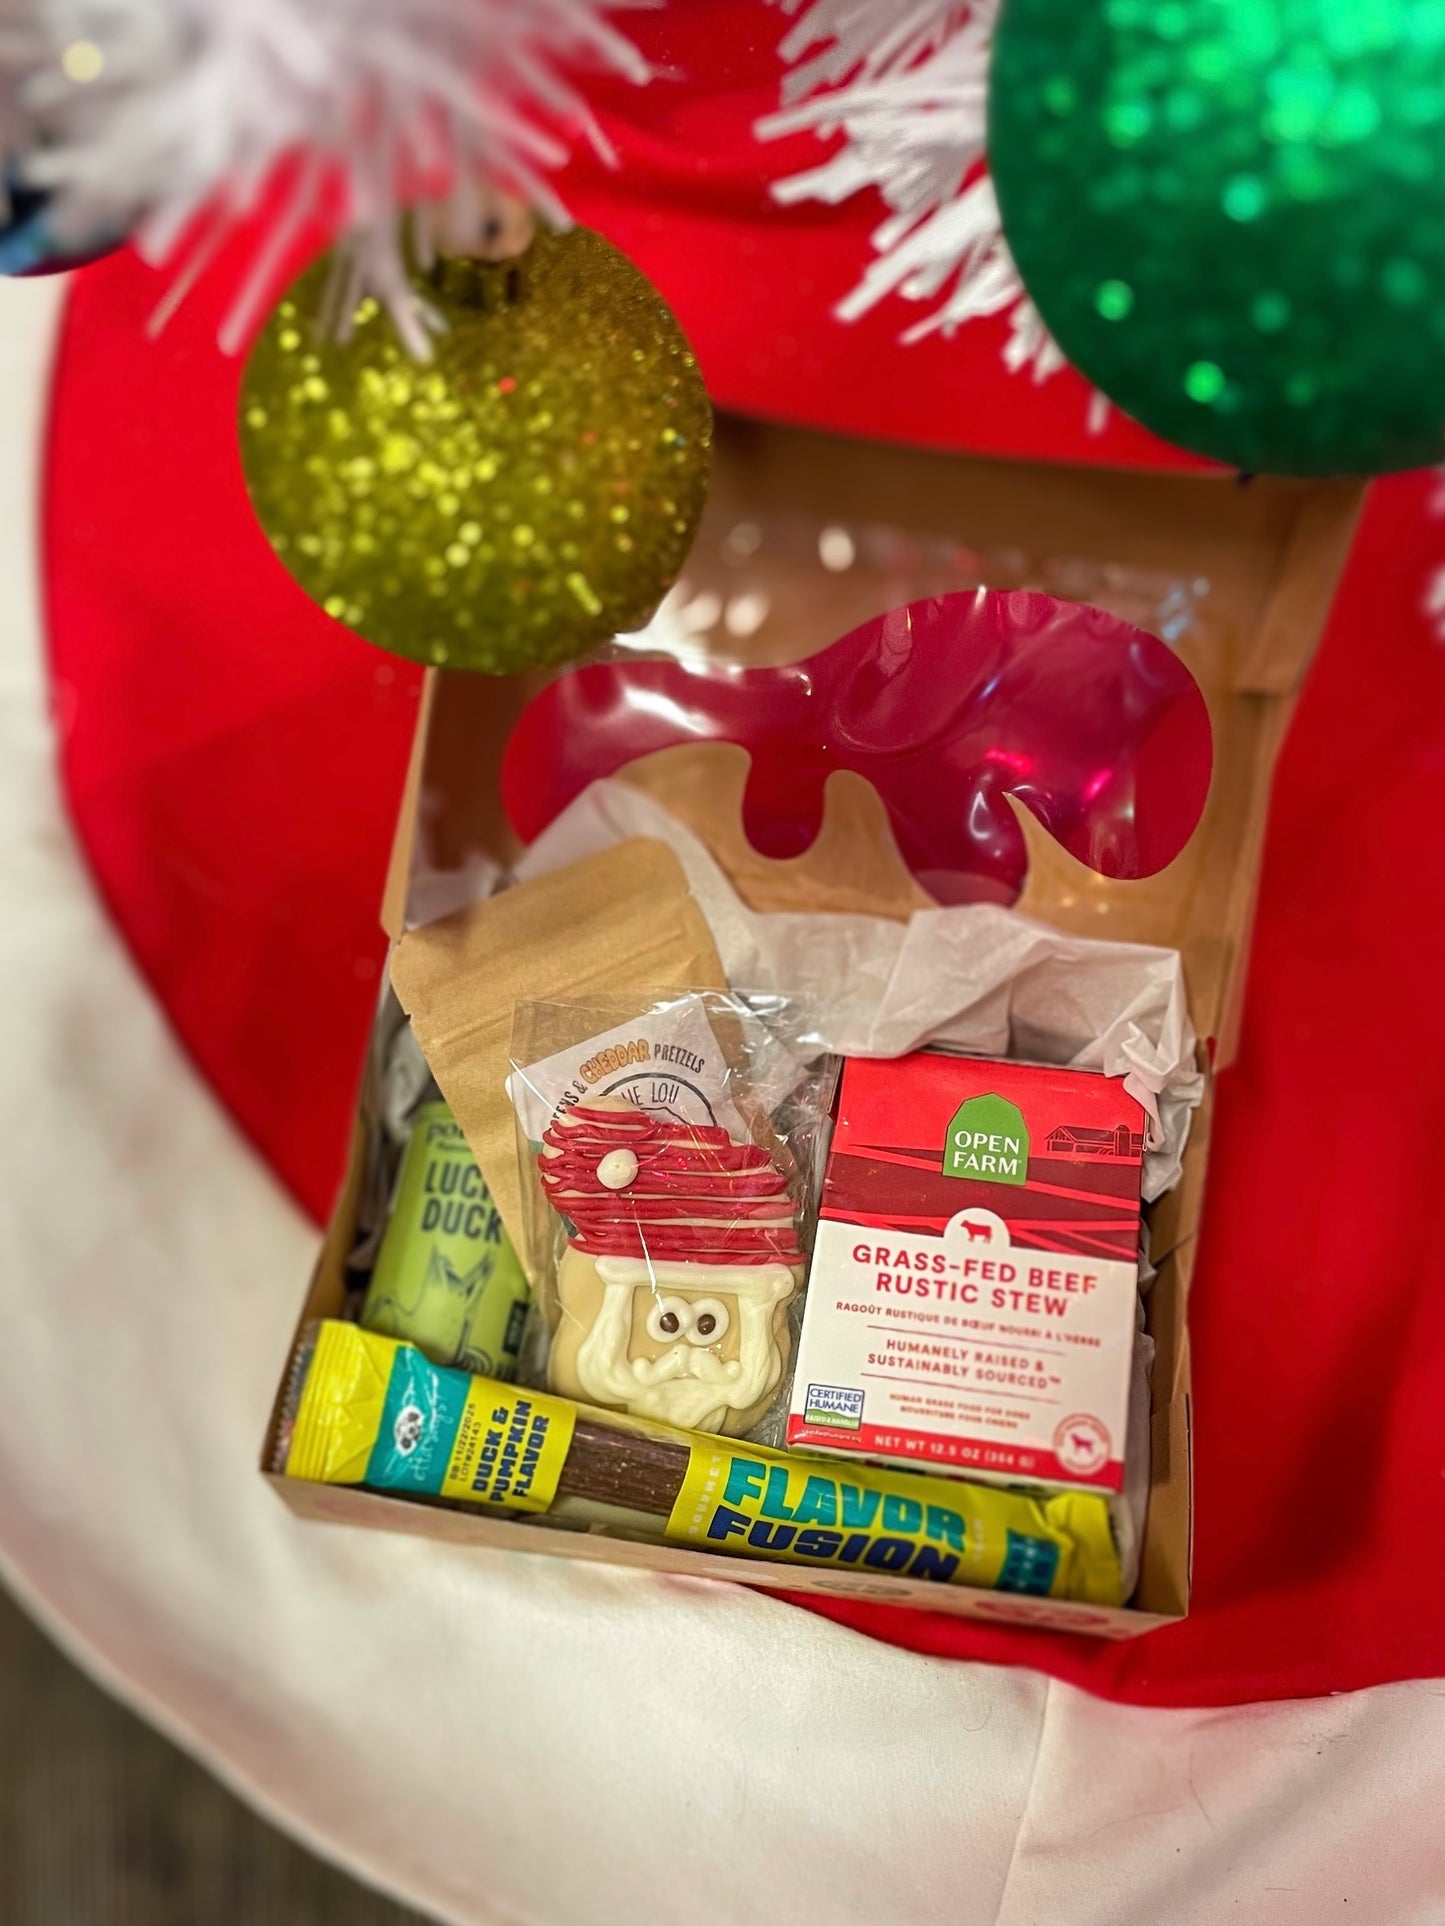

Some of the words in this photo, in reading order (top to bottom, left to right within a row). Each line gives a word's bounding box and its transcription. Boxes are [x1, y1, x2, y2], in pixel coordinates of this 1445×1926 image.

[579, 1039, 649, 1084] CHEDDAR
[654, 1043, 705, 1074] PRETZELS
[572, 1080, 588, 1094] &
[652, 1082, 680, 1104] LOU
[954, 1130, 1019, 1155] OPEN
[952, 1151, 1018, 1176] FARM
[420, 1197, 502, 1245] DUCK
[852, 1244, 1016, 1284] GRASS-FED
[1027, 1267, 1099, 1295] BEEF
[875, 1272, 979, 1304] RUSTIC
[990, 1288, 1069, 1318] STEW
[836, 1301, 882, 1316] RAGOÛT
[885, 1307, 940, 1325] RUSTIQUE
[943, 1315, 959, 1327] DE
[867, 1353, 969, 1379] SUSTAINABLY
[886, 1338, 969, 1361] HUMANELY
[973, 1353, 1030, 1370] RAISED
[1034, 1360, 1044, 1372] &
[809, 1398, 859, 1414] HUMANE
[810, 1387, 862, 1403] CERTIFIED
[453, 1403, 476, 1463] 11/22/2025
[471, 1429, 503, 1493] DUCK
[491, 1406, 509, 1425] &
[874, 1434, 901, 1449] NET
[905, 1437, 926, 1451] WT
[930, 1441, 957, 1457] 12.5
[960, 1446, 981, 1461] OZ
[489, 1400, 532, 1502] PUMPKIN
[511, 1415, 550, 1497] FLAVOR
[722, 1457, 966, 1552] FLAVOR
[706, 1504, 961, 1582] FUSION
